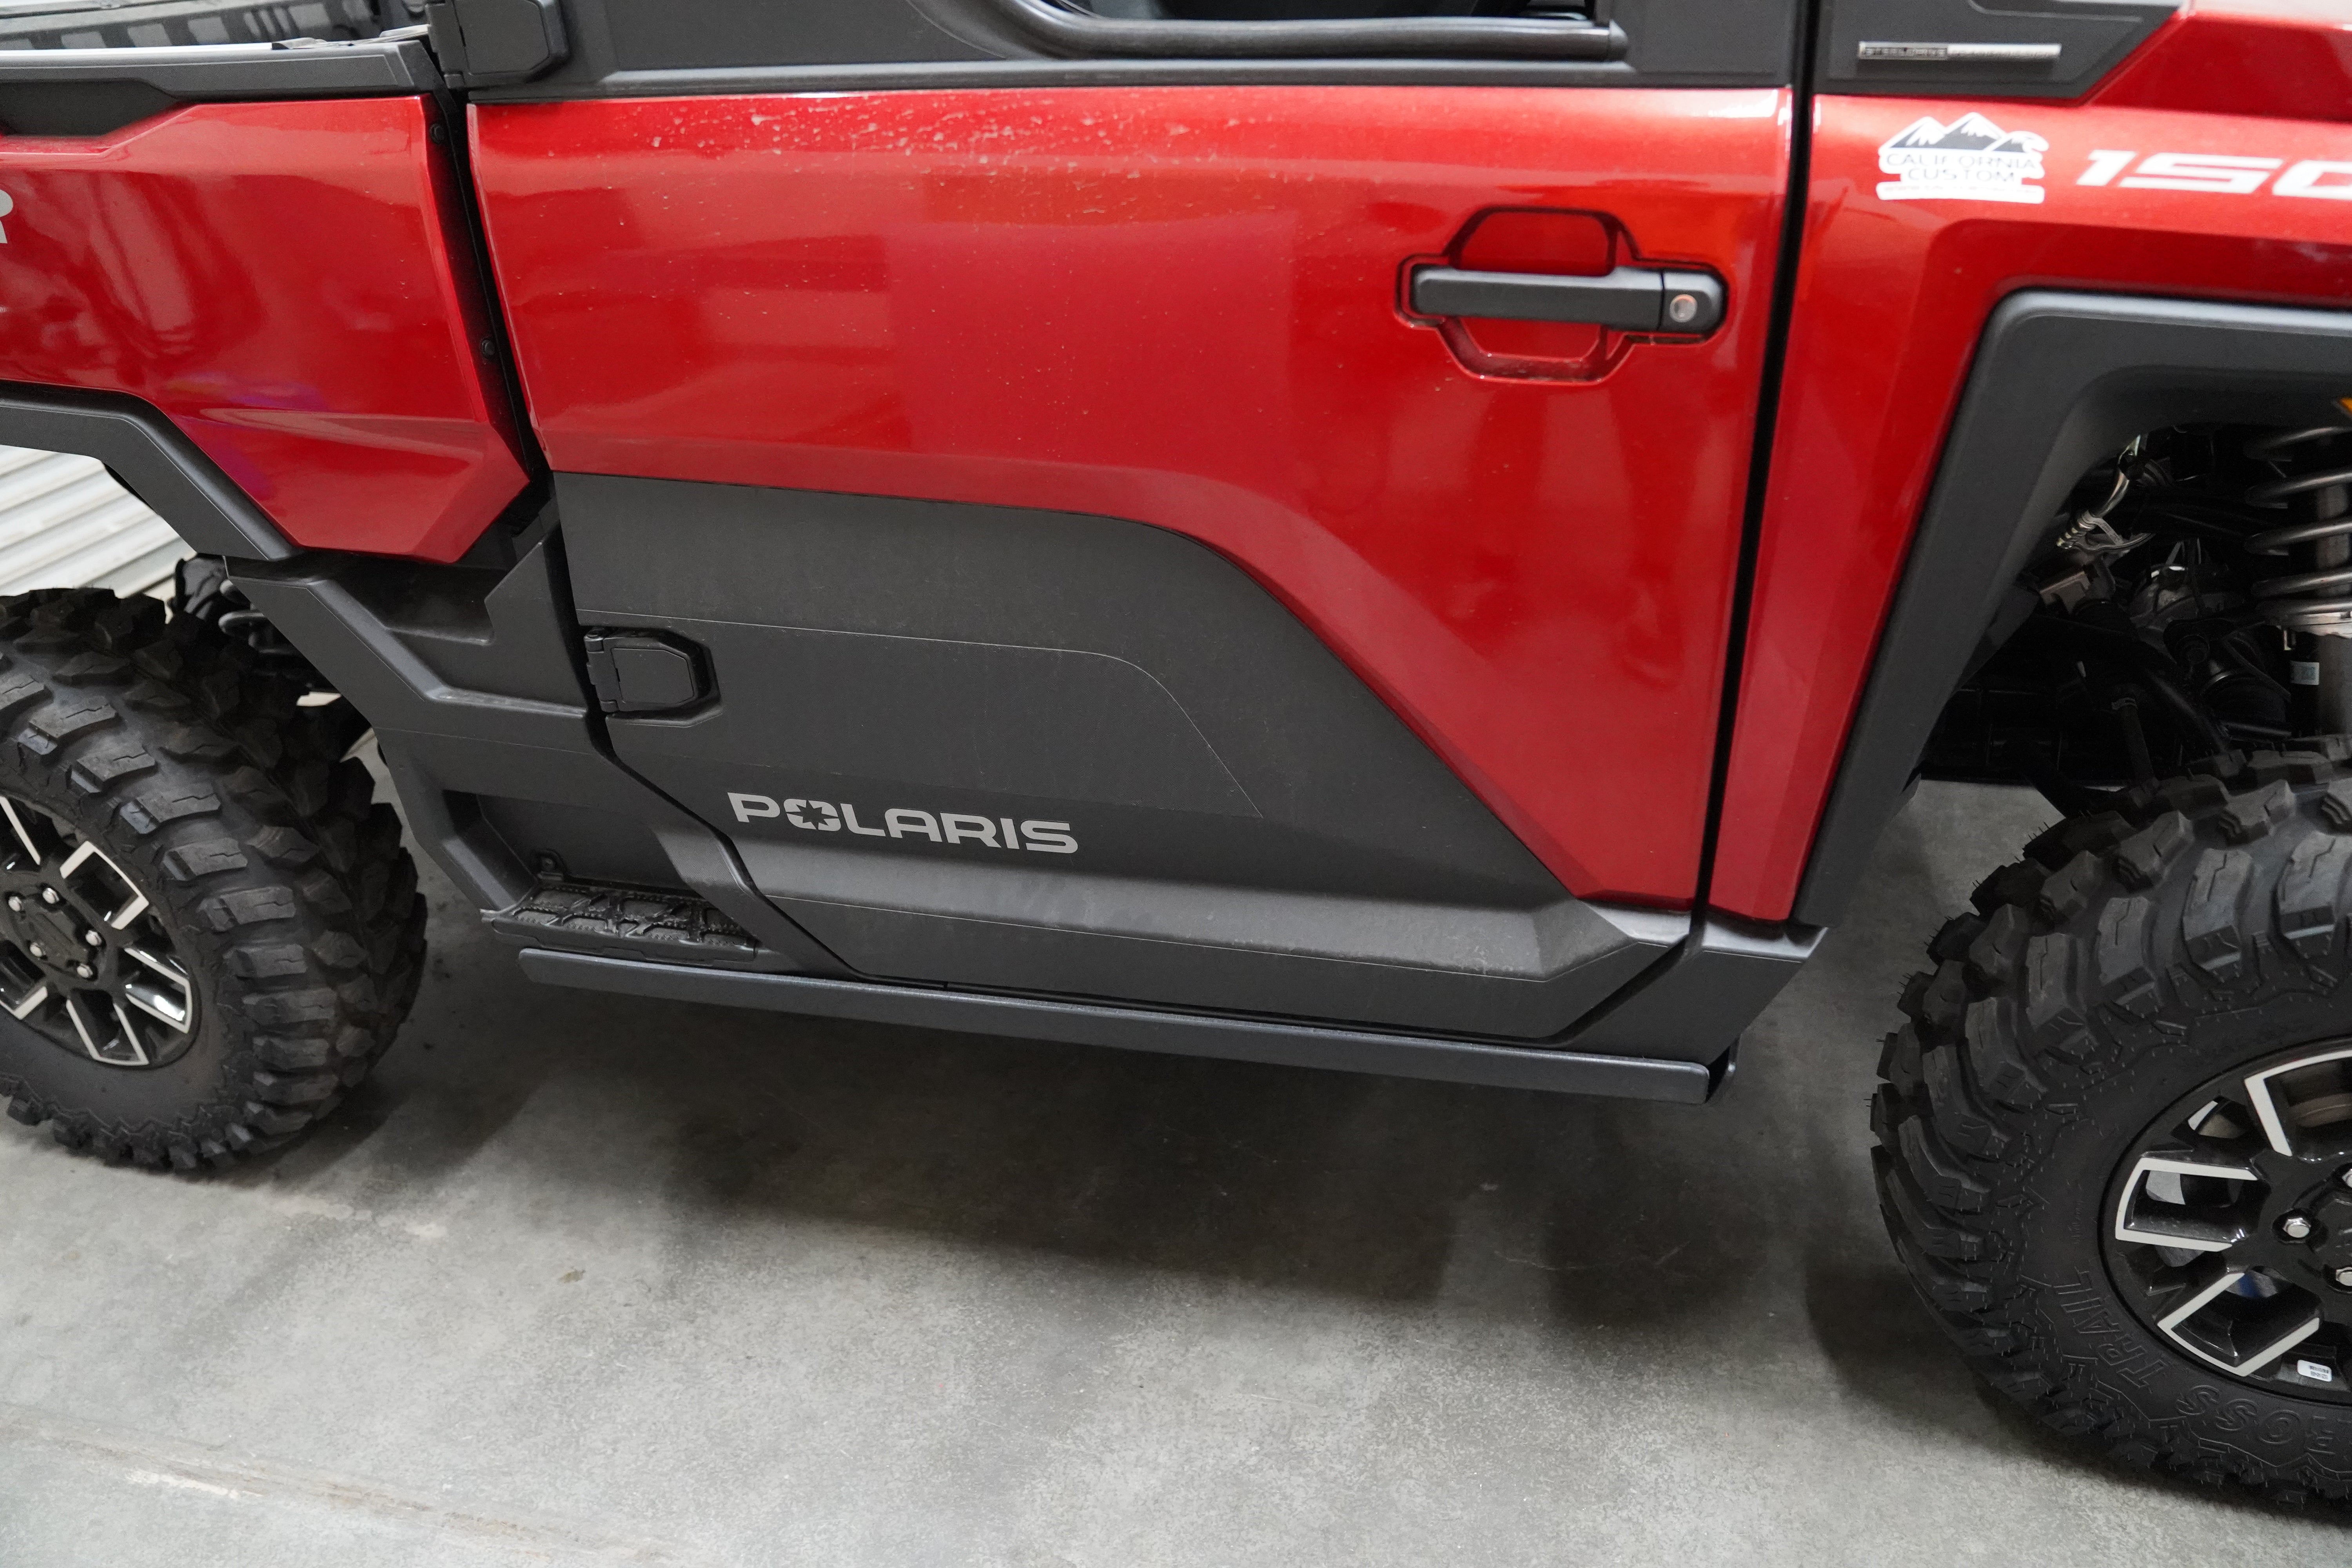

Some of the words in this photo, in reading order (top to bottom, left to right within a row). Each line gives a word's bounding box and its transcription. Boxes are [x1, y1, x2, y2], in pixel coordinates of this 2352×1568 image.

[1886, 153, 2036, 169] CALIFORNIA
[1908, 169, 2015, 182] CUSTOM
[727, 792, 1078, 854] POLARIS
[2053, 1270, 2169, 1388] TRAIL
